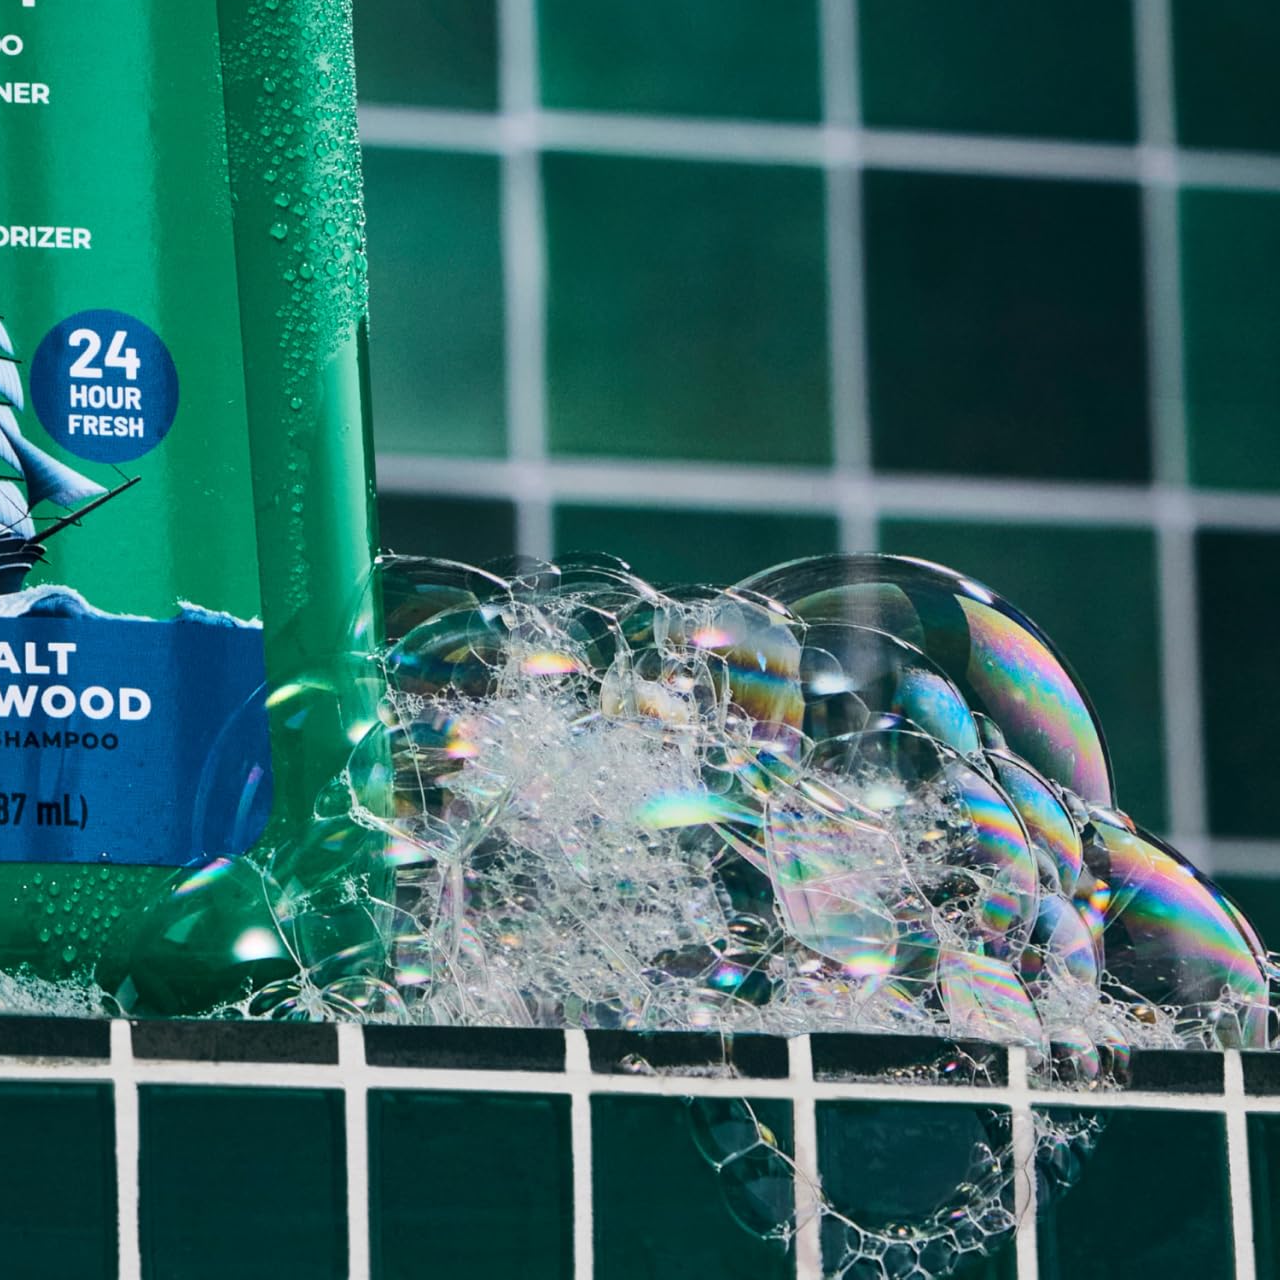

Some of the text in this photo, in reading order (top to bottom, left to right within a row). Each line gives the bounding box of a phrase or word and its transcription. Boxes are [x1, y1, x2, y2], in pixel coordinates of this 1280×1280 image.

[68, 328, 141, 380] 24
[70, 384, 142, 410] HOUR
[68, 414, 144, 438] FRESH
[36, 793, 88, 831] mL)
